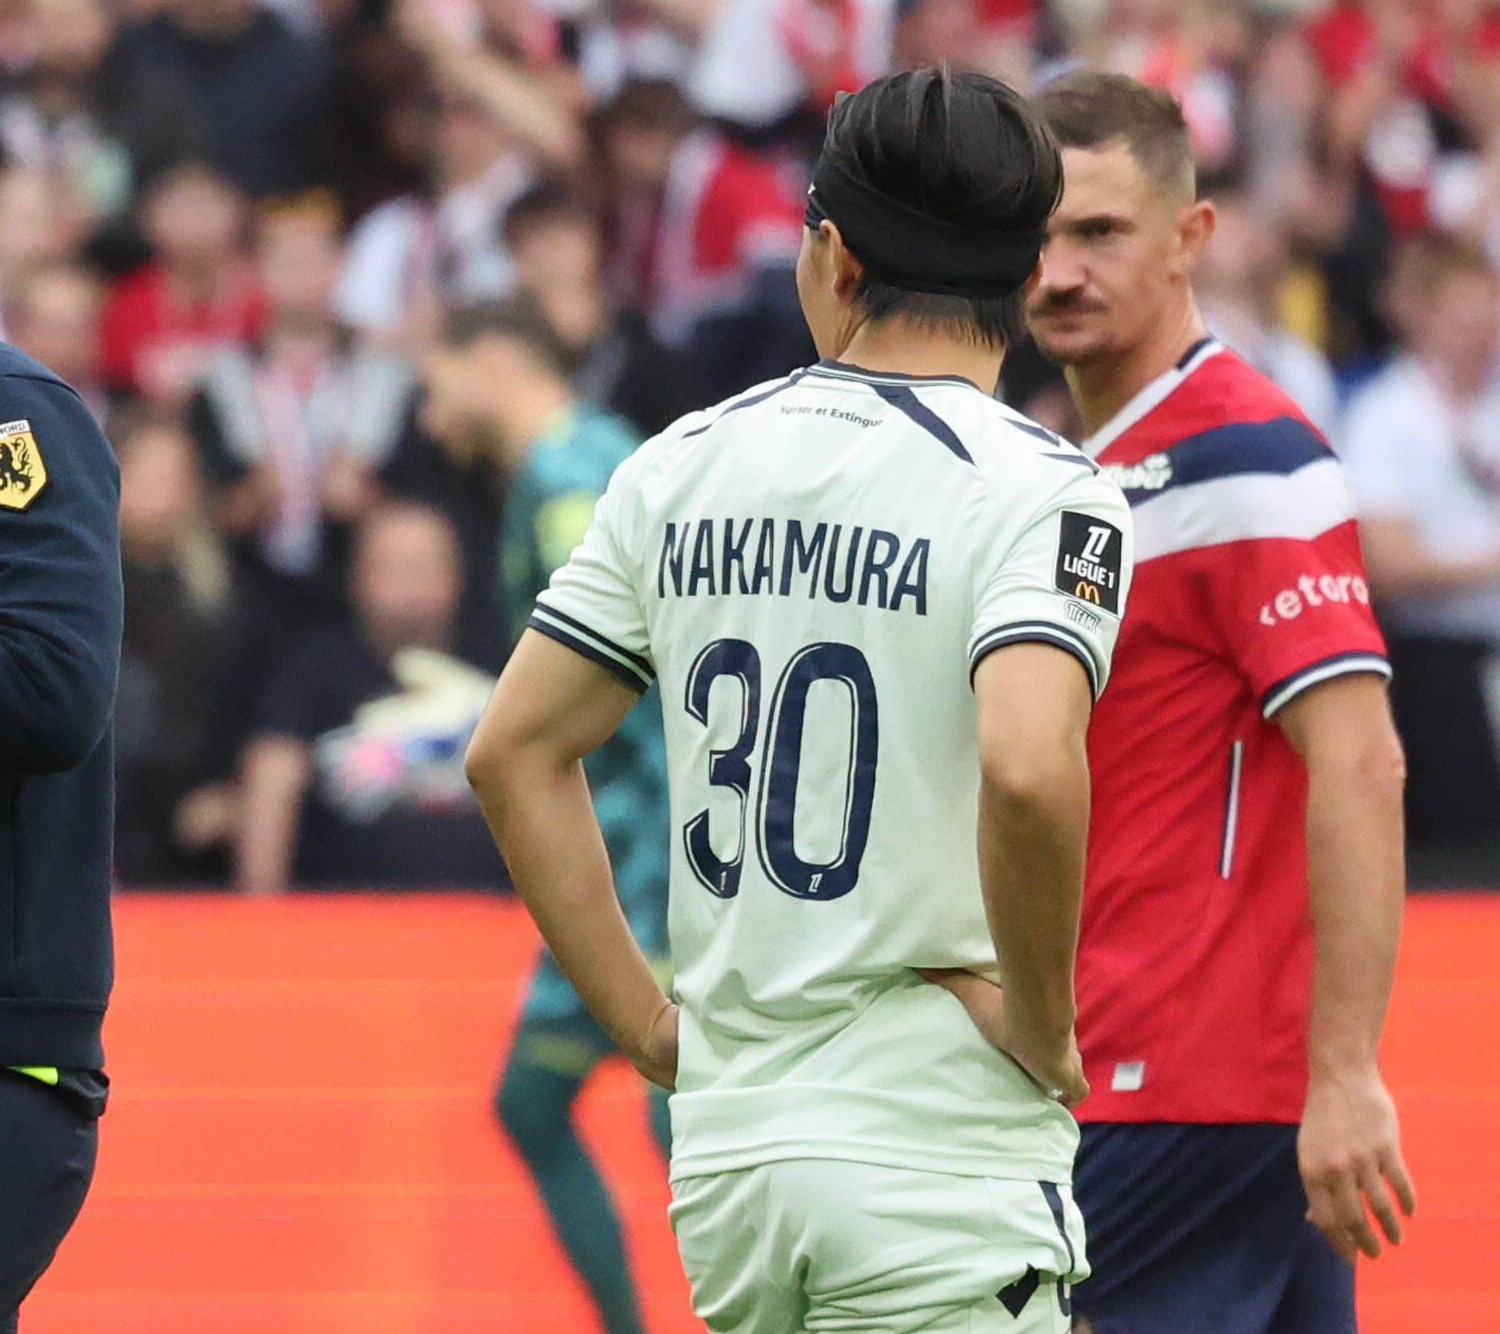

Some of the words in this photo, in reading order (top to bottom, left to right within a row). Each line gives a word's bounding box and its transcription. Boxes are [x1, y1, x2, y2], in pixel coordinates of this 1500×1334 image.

[658, 518, 931, 616] NAKAMURA
[1063, 554, 1107, 586] LIGUE
[1108, 572, 1115, 588] 1
[683, 638, 879, 901] 30
